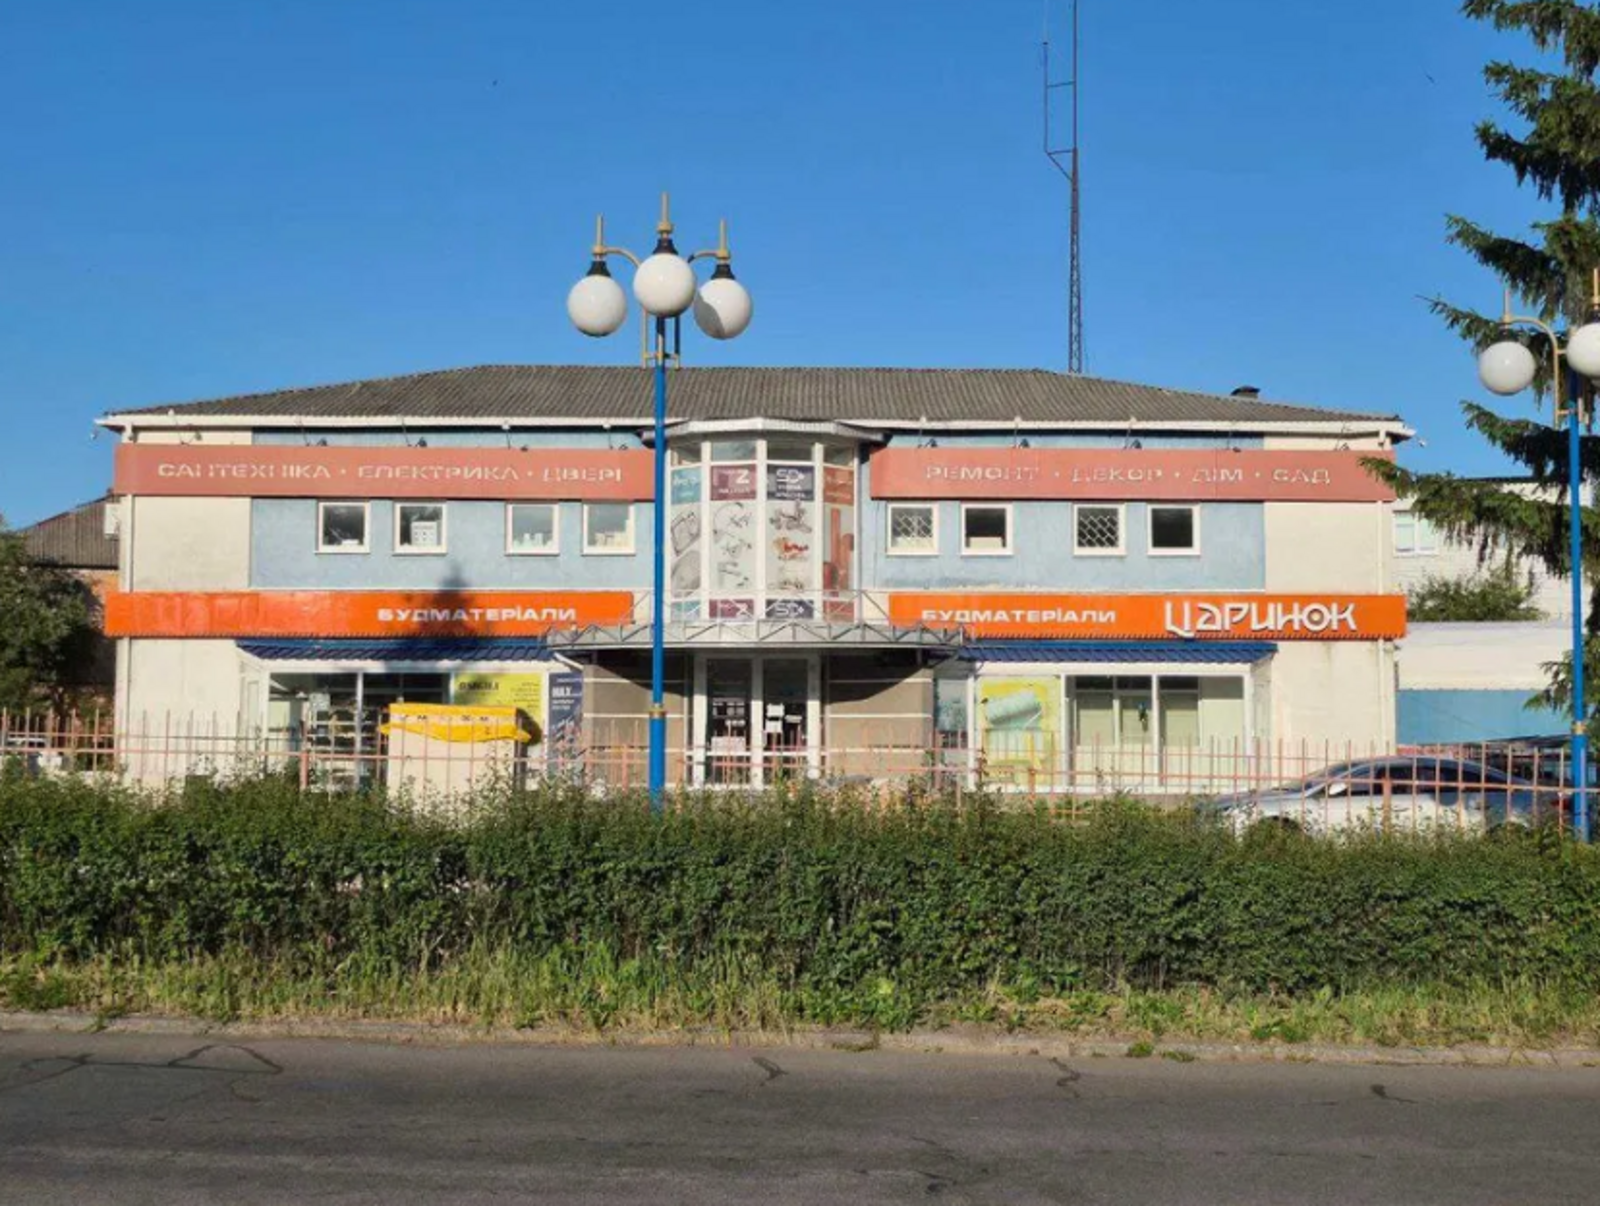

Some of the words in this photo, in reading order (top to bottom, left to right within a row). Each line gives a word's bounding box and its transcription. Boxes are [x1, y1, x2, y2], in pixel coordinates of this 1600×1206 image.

[357, 464, 521, 480] ЕЛЕКТРИКА
[1272, 467, 1331, 484] САД
[377, 605, 577, 623] БУДМАТЕРІАЛИ
[921, 608, 1117, 624] БУДМАТЕРІАЛИ
[1164, 601, 1358, 639] ЦАРИНОК
